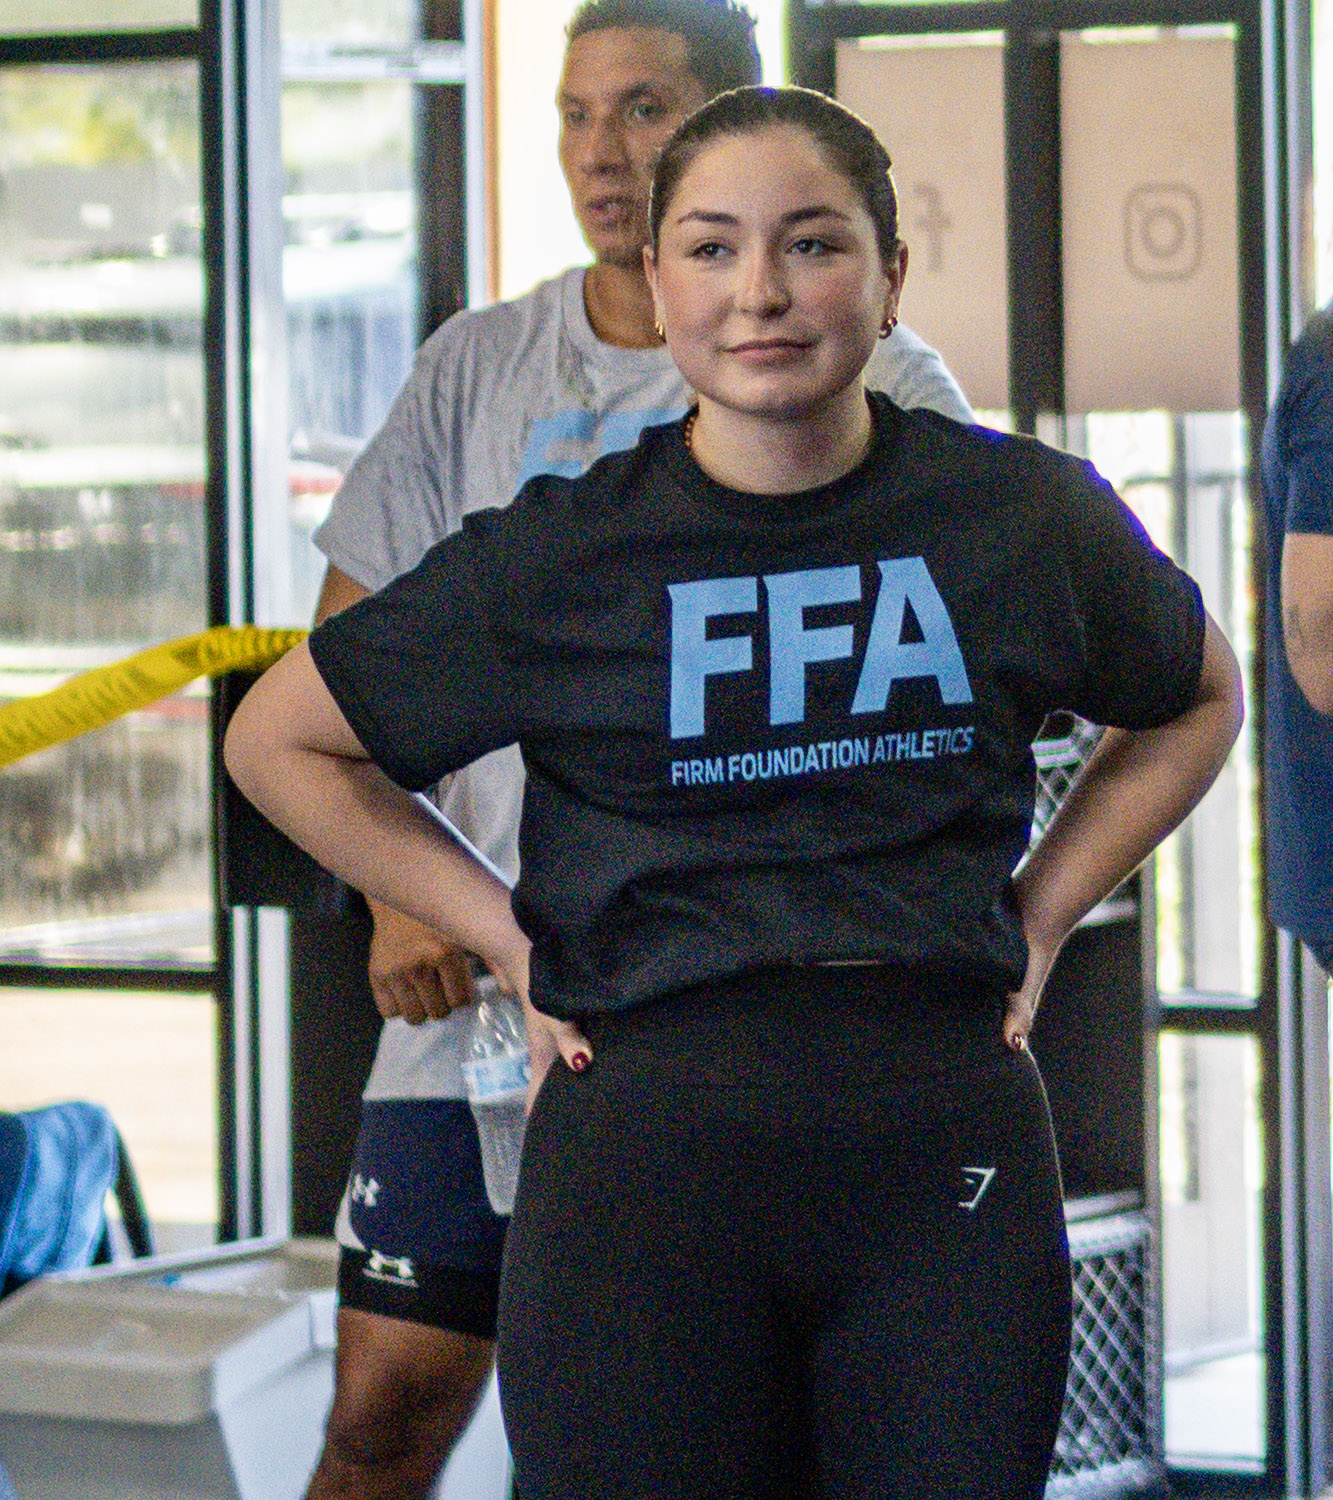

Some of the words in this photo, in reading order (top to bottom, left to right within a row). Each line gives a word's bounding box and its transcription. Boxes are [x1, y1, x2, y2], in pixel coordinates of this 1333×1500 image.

[667, 556, 973, 739] FFA
[671, 756, 725, 786] FIRM
[727, 738, 871, 782] FOUNDATION
[871, 725, 976, 764] ATHLETICS
